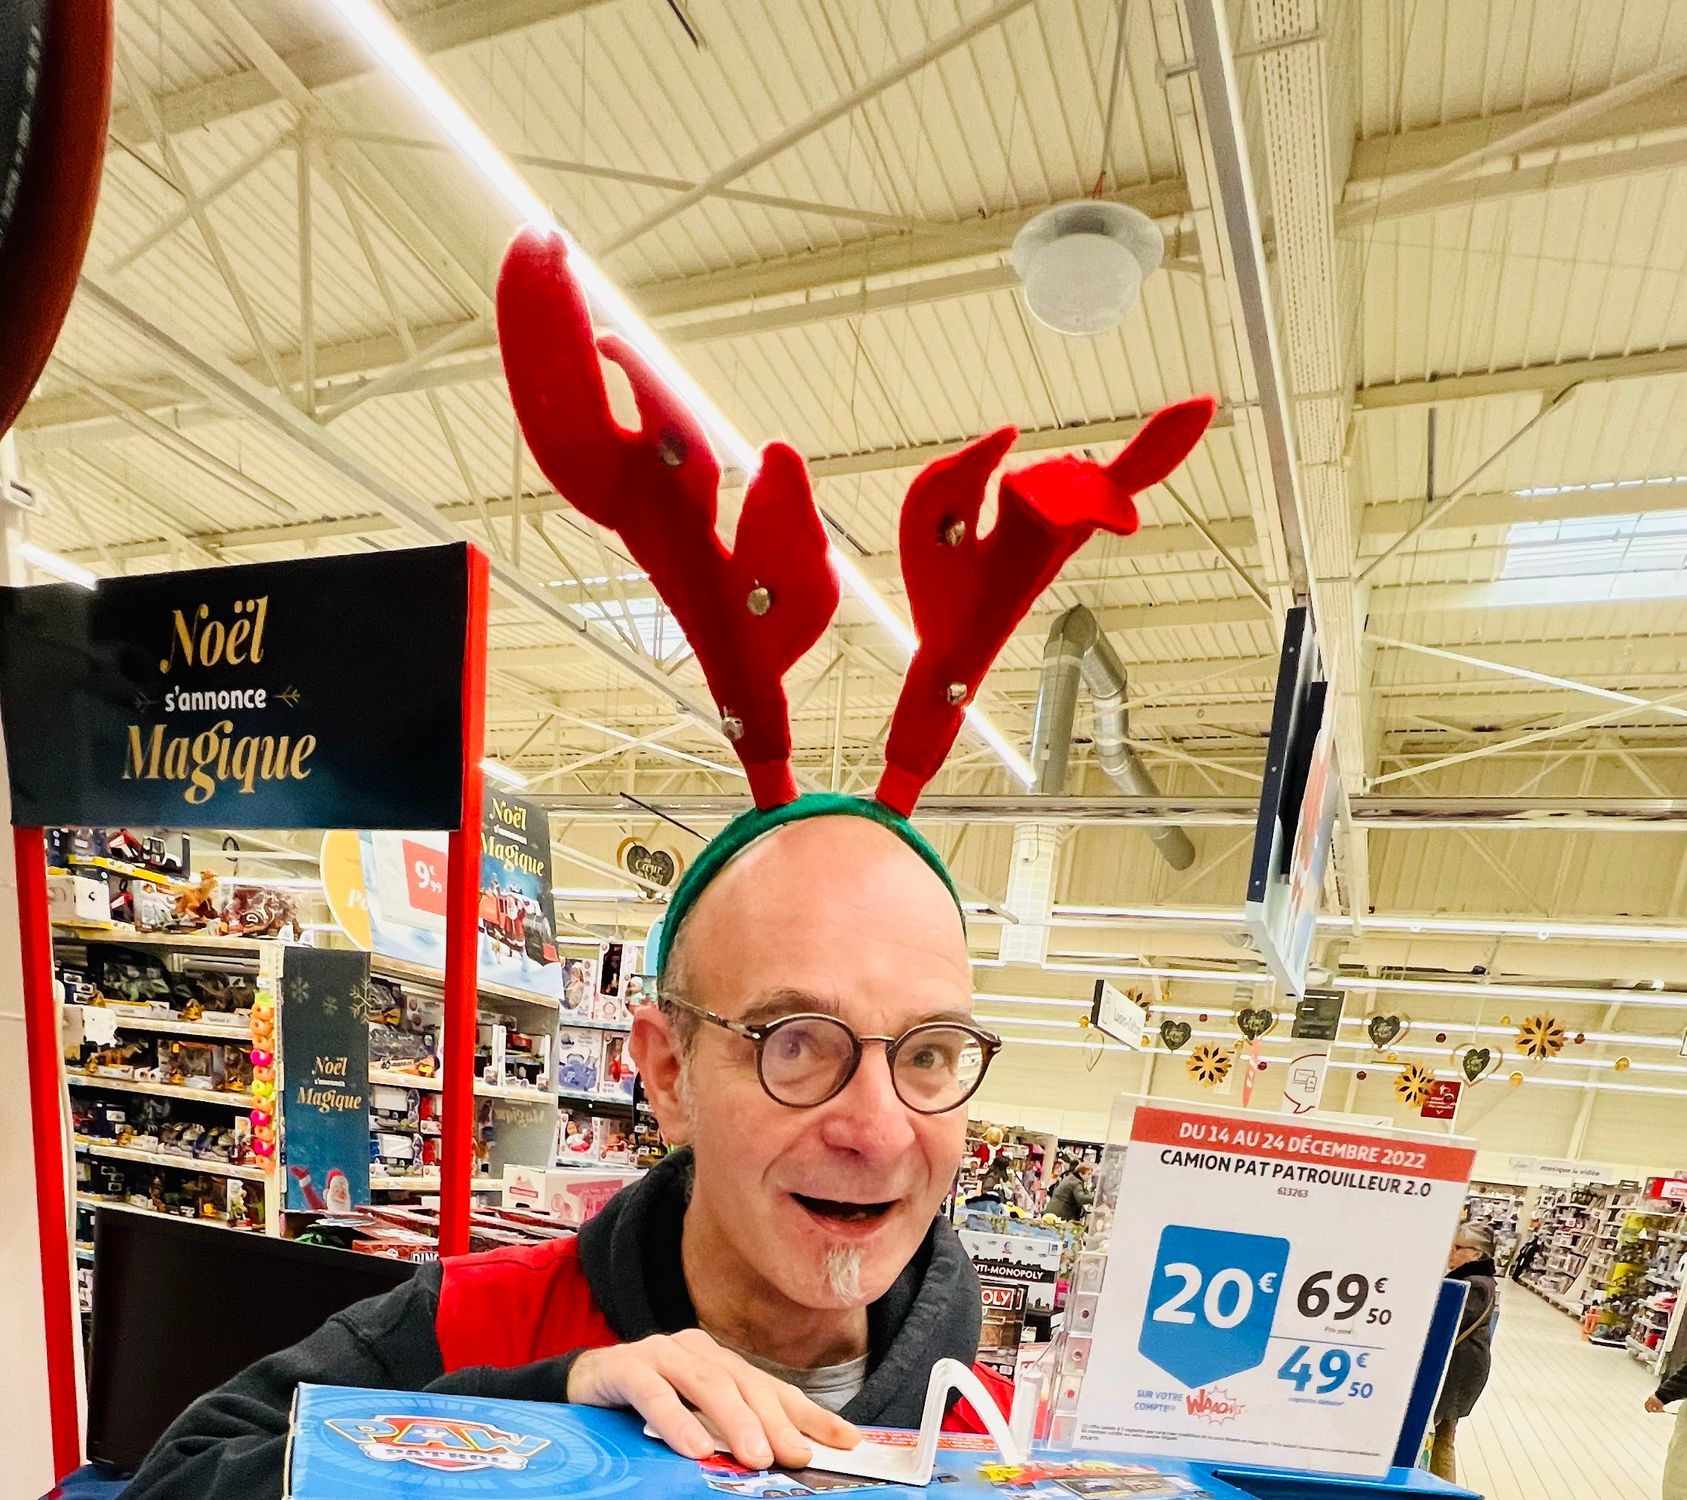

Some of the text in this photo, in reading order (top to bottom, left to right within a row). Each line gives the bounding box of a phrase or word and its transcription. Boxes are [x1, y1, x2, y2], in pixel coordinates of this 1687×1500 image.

[159, 595, 269, 674] Noël
[165, 685, 267, 712] s'annonce
[123, 719, 317, 805] Magique
[489, 797, 527, 831] Noël
[481, 831, 545, 877] Magique
[311, 1056, 348, 1076] Noël
[297, 1086, 362, 1113] Magique
[1179, 1122, 1427, 1169] DU 14 AU 24 DÉCEMBRE 2022
[1160, 1149, 1431, 1197] CAMION PAT PATROUILLEUR 2.0
[981, 1289, 1011, 1306] OLY
[1136, 1388, 1184, 1402] SUR VOTRE
[324, 1417, 551, 1458] PAW
[384, 1448, 508, 1465] PATROL
